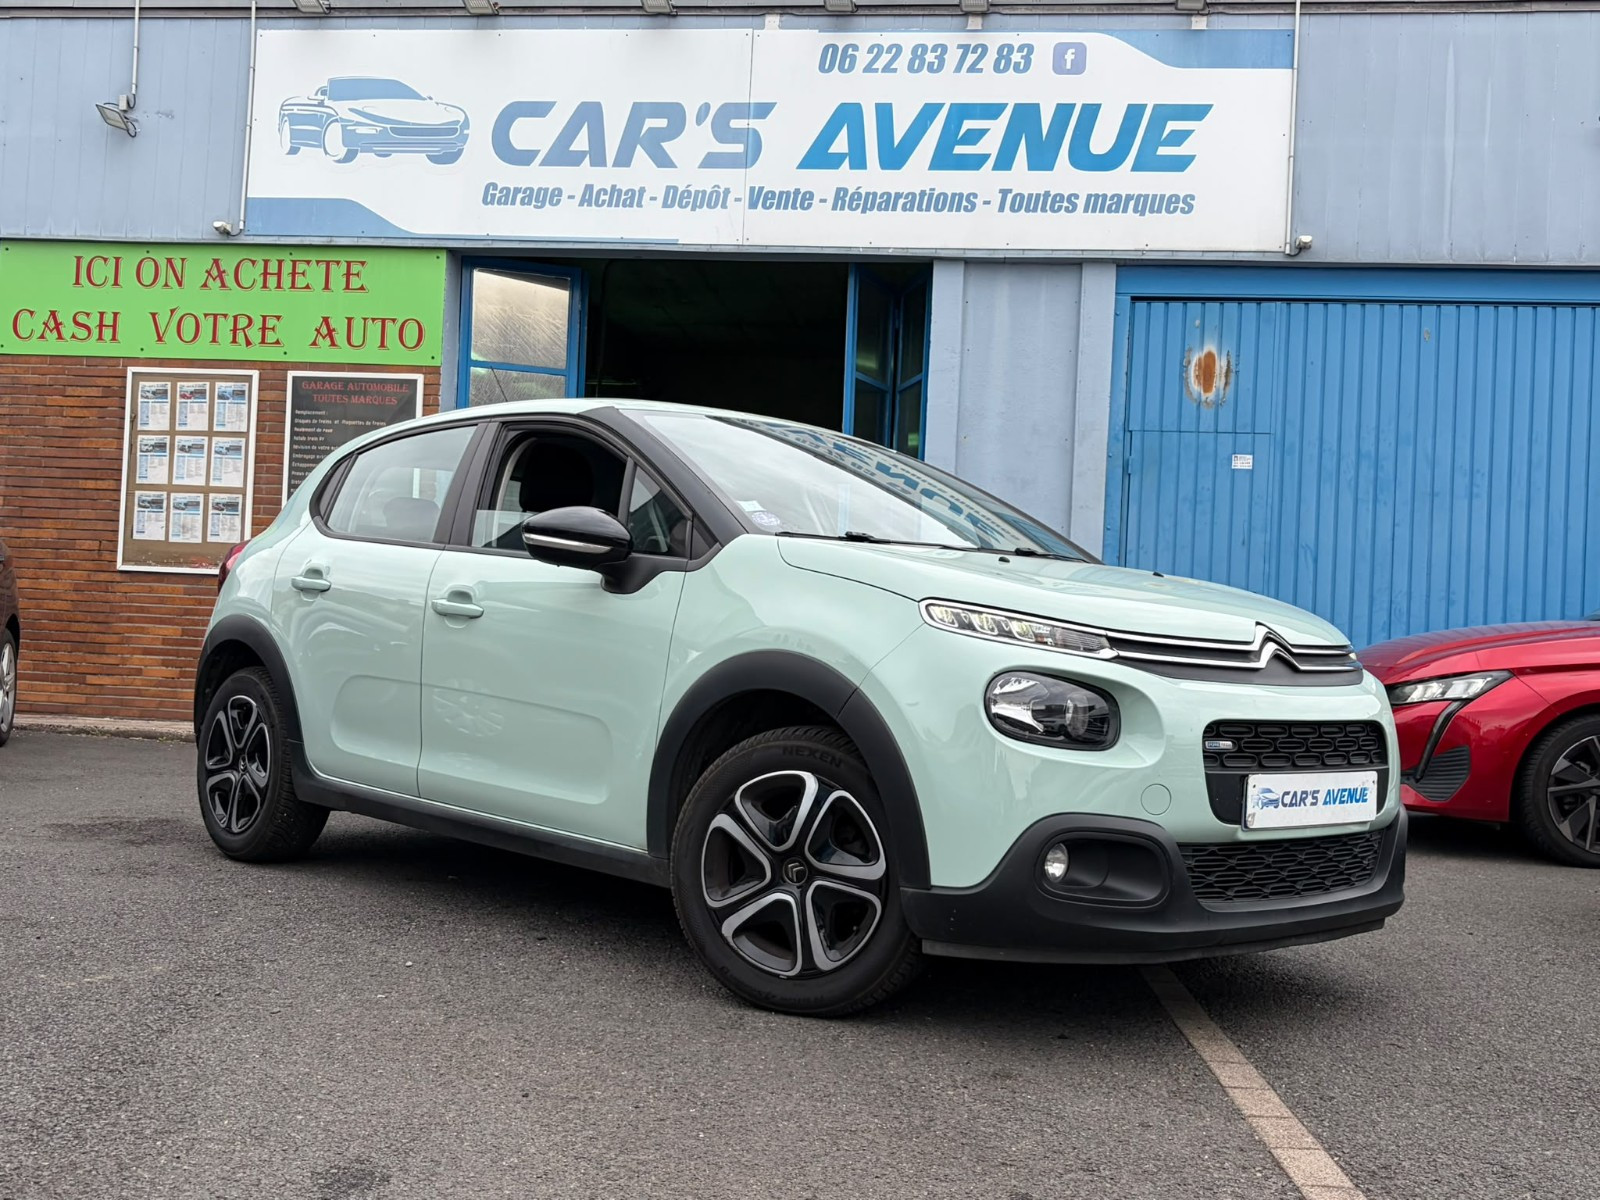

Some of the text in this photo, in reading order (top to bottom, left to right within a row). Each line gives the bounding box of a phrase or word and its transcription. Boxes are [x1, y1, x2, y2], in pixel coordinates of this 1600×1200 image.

[818, 44, 1035, 74] 06 22 83 72 83
[492, 101, 1214, 172] CAR'S AVENUE
[482, 182, 564, 208] Garage
[580, 183, 647, 208] Achat
[662, 184, 730, 212] Dépôt
[747, 186, 814, 210] Vente
[830, 186, 978, 214] Réparations
[998, 188, 1079, 214] Toutes
[1082, 191, 1195, 216] marques
[72, 255, 368, 293] ICI ON ACHETE
[12, 306, 426, 352] CASH VOTRE AUTO
[302, 381, 410, 392] GARAGE AUTOMOBILE
[314, 394, 398, 405] TOUTES MARQUES
[782, 745, 842, 768] NEXEN
[1280, 786, 1369, 808] CAR'S AVENUE
